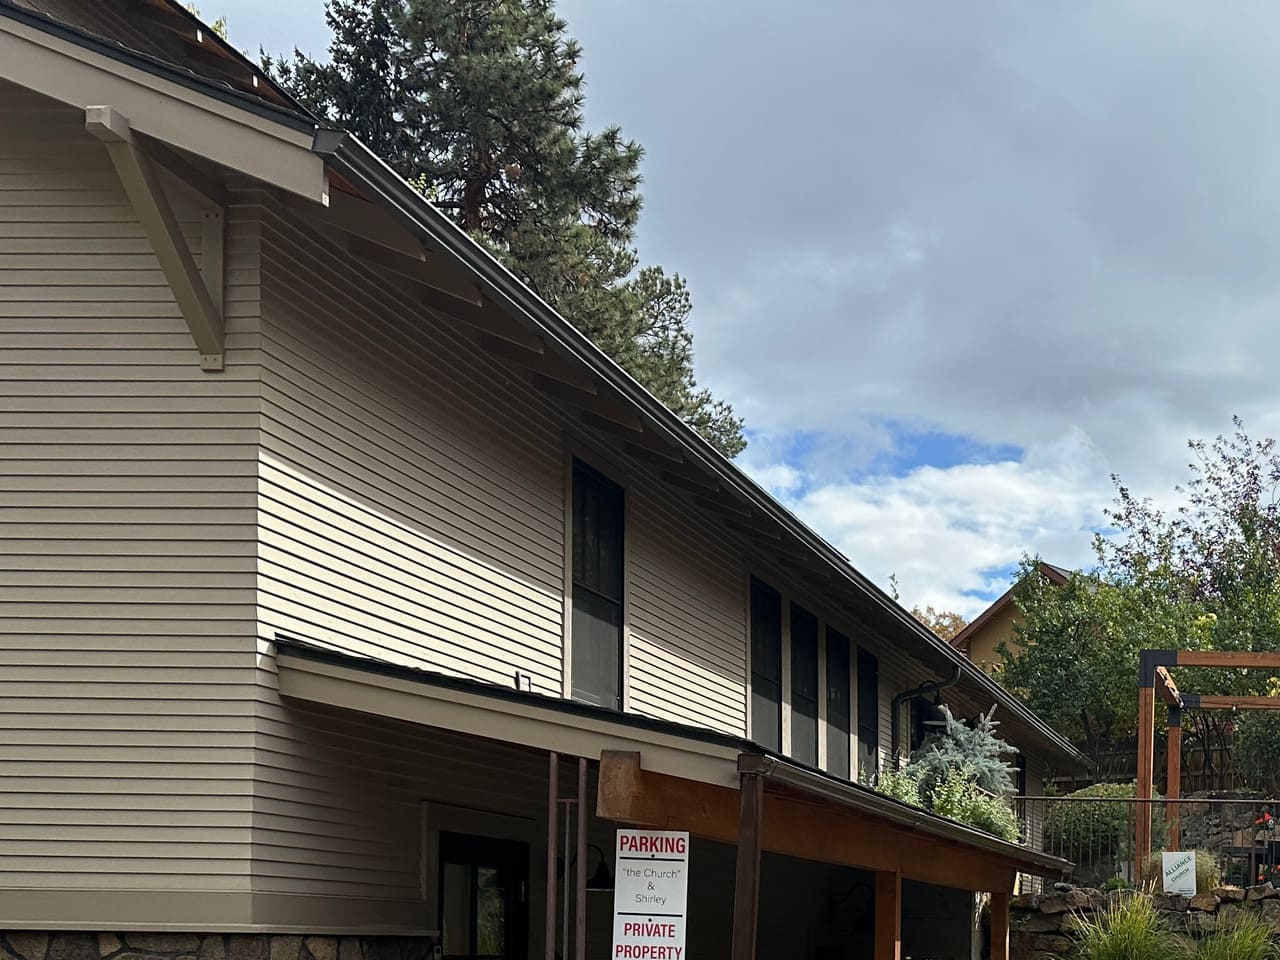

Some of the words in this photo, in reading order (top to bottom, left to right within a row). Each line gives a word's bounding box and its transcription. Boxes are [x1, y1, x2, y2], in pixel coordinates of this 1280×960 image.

[619, 835, 686, 853] PARKING
[623, 867, 641, 877] "the
[643, 868, 681, 879] Church"
[1165, 855, 1192, 877] ALLIANCE
[647, 881, 655, 891] &
[634, 894, 667, 905] Shirley
[623, 922, 676, 938] PRIVATE
[615, 944, 683, 960] PROPERTY
